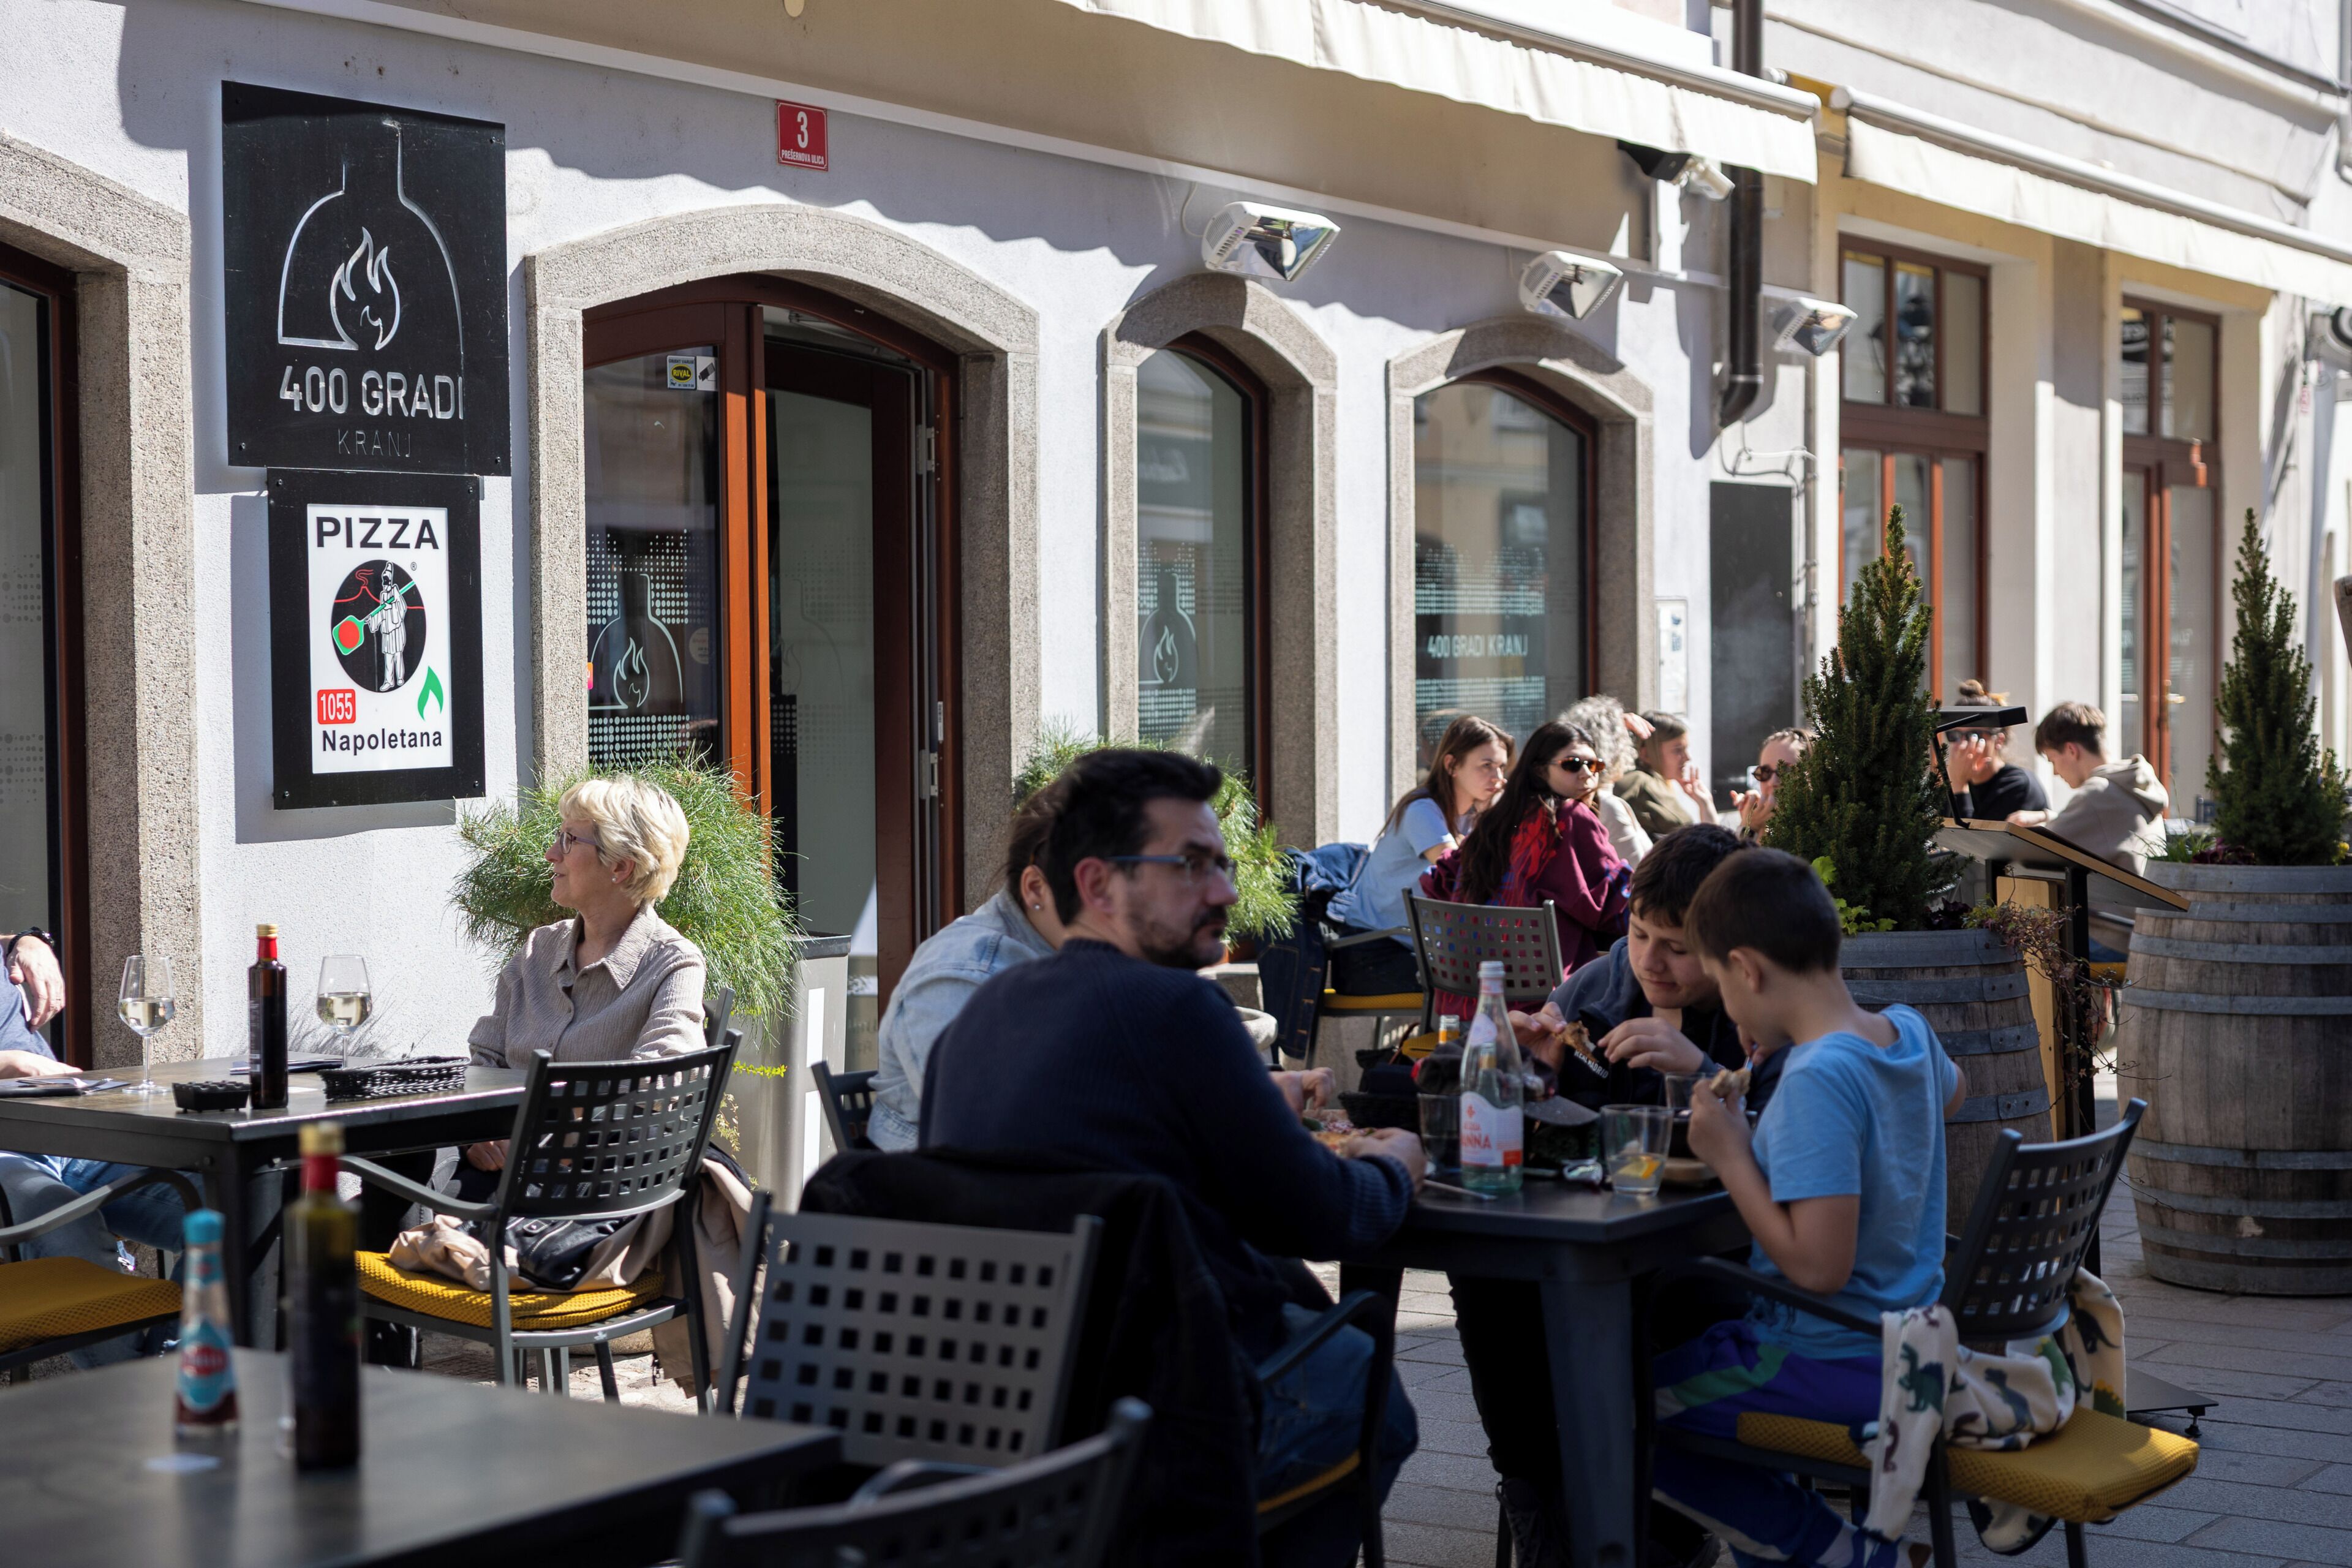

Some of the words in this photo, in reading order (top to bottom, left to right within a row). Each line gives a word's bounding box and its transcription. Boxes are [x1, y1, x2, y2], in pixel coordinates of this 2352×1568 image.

[797, 111, 809, 148] 3
[781, 149, 811, 163] PREŠERNOVA
[812, 154, 824, 165] ULICA
[673, 369, 691, 379] RIVAL
[279, 366, 349, 414] 400
[361, 370, 464, 420] GRADI
[338, 428, 411, 458] KRANJ
[316, 516, 439, 550] PIZZA
[1427, 635, 1450, 659] 400
[1487, 633, 1528, 657] KRANJ
[320, 693, 353, 721] 1055
[322, 728, 442, 756] Napoletana
[1574, 1049, 1588, 1064] REAL
[1587, 1059, 1609, 1079] MADRID
[1460, 1133, 1492, 1150] ANNA
